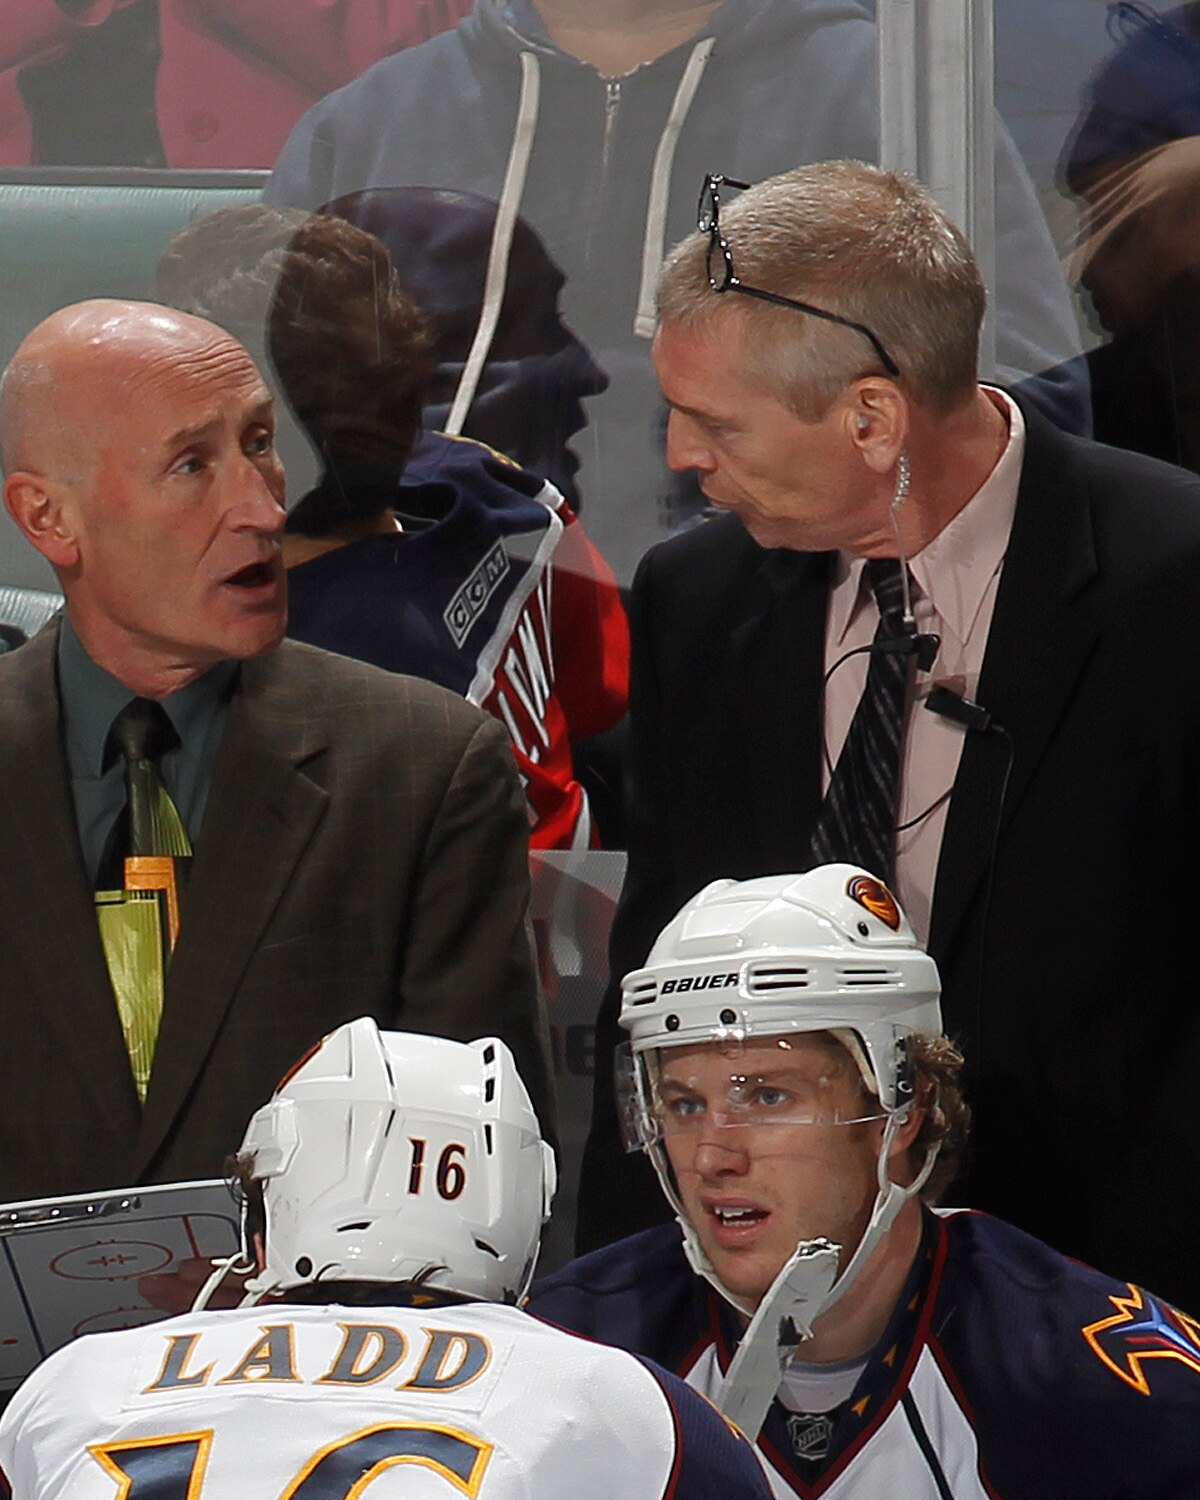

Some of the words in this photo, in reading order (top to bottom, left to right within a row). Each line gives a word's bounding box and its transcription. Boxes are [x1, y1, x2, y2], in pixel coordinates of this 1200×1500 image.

[452, 550, 507, 631] CCM
[407, 1138, 467, 1201] 16
[140, 1322, 495, 1396] LADD
